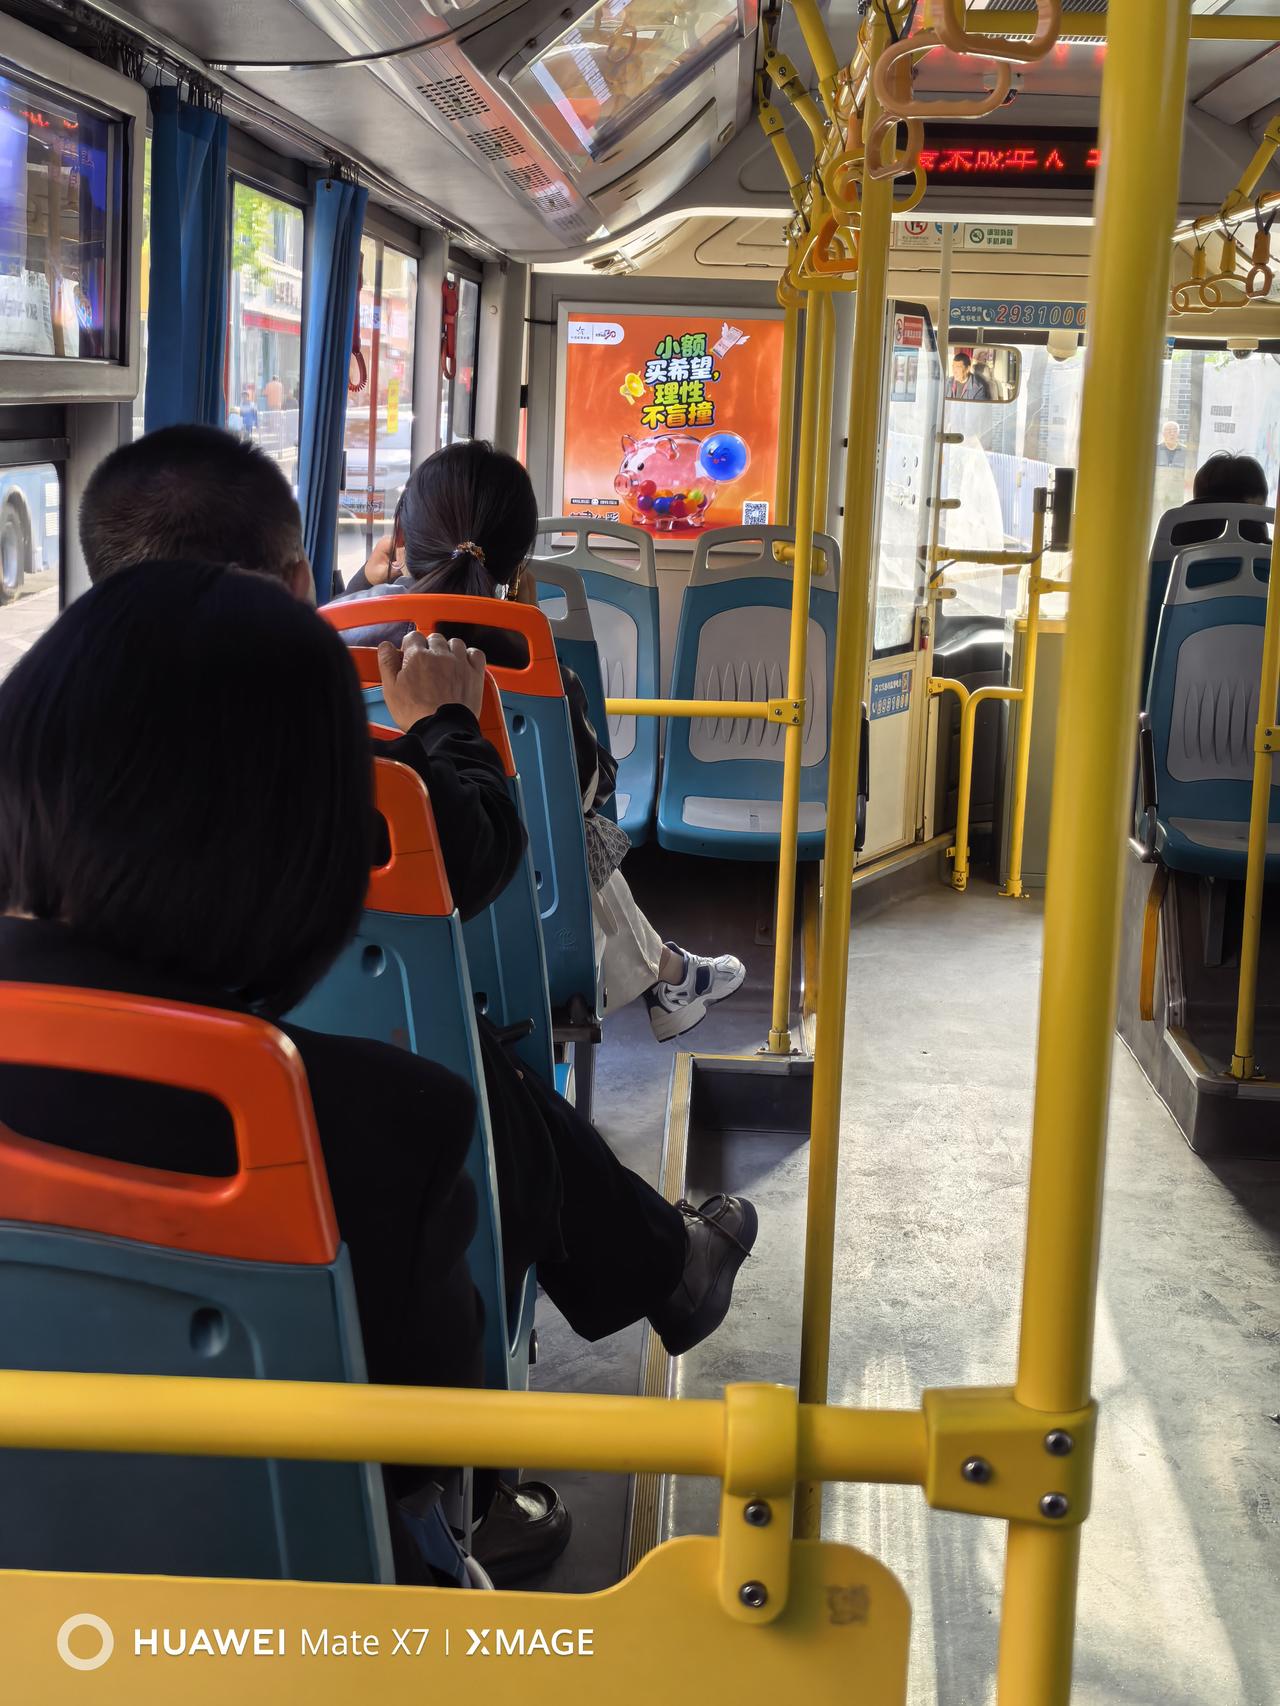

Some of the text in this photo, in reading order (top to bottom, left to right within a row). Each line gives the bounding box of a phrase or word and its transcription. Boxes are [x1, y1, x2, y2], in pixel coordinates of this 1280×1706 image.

[995, 304, 1087, 325] 2931000
[655, 333, 707, 360] 小额
[654, 380, 705, 405] 理性
[640, 401, 714, 429] 不盲撞
